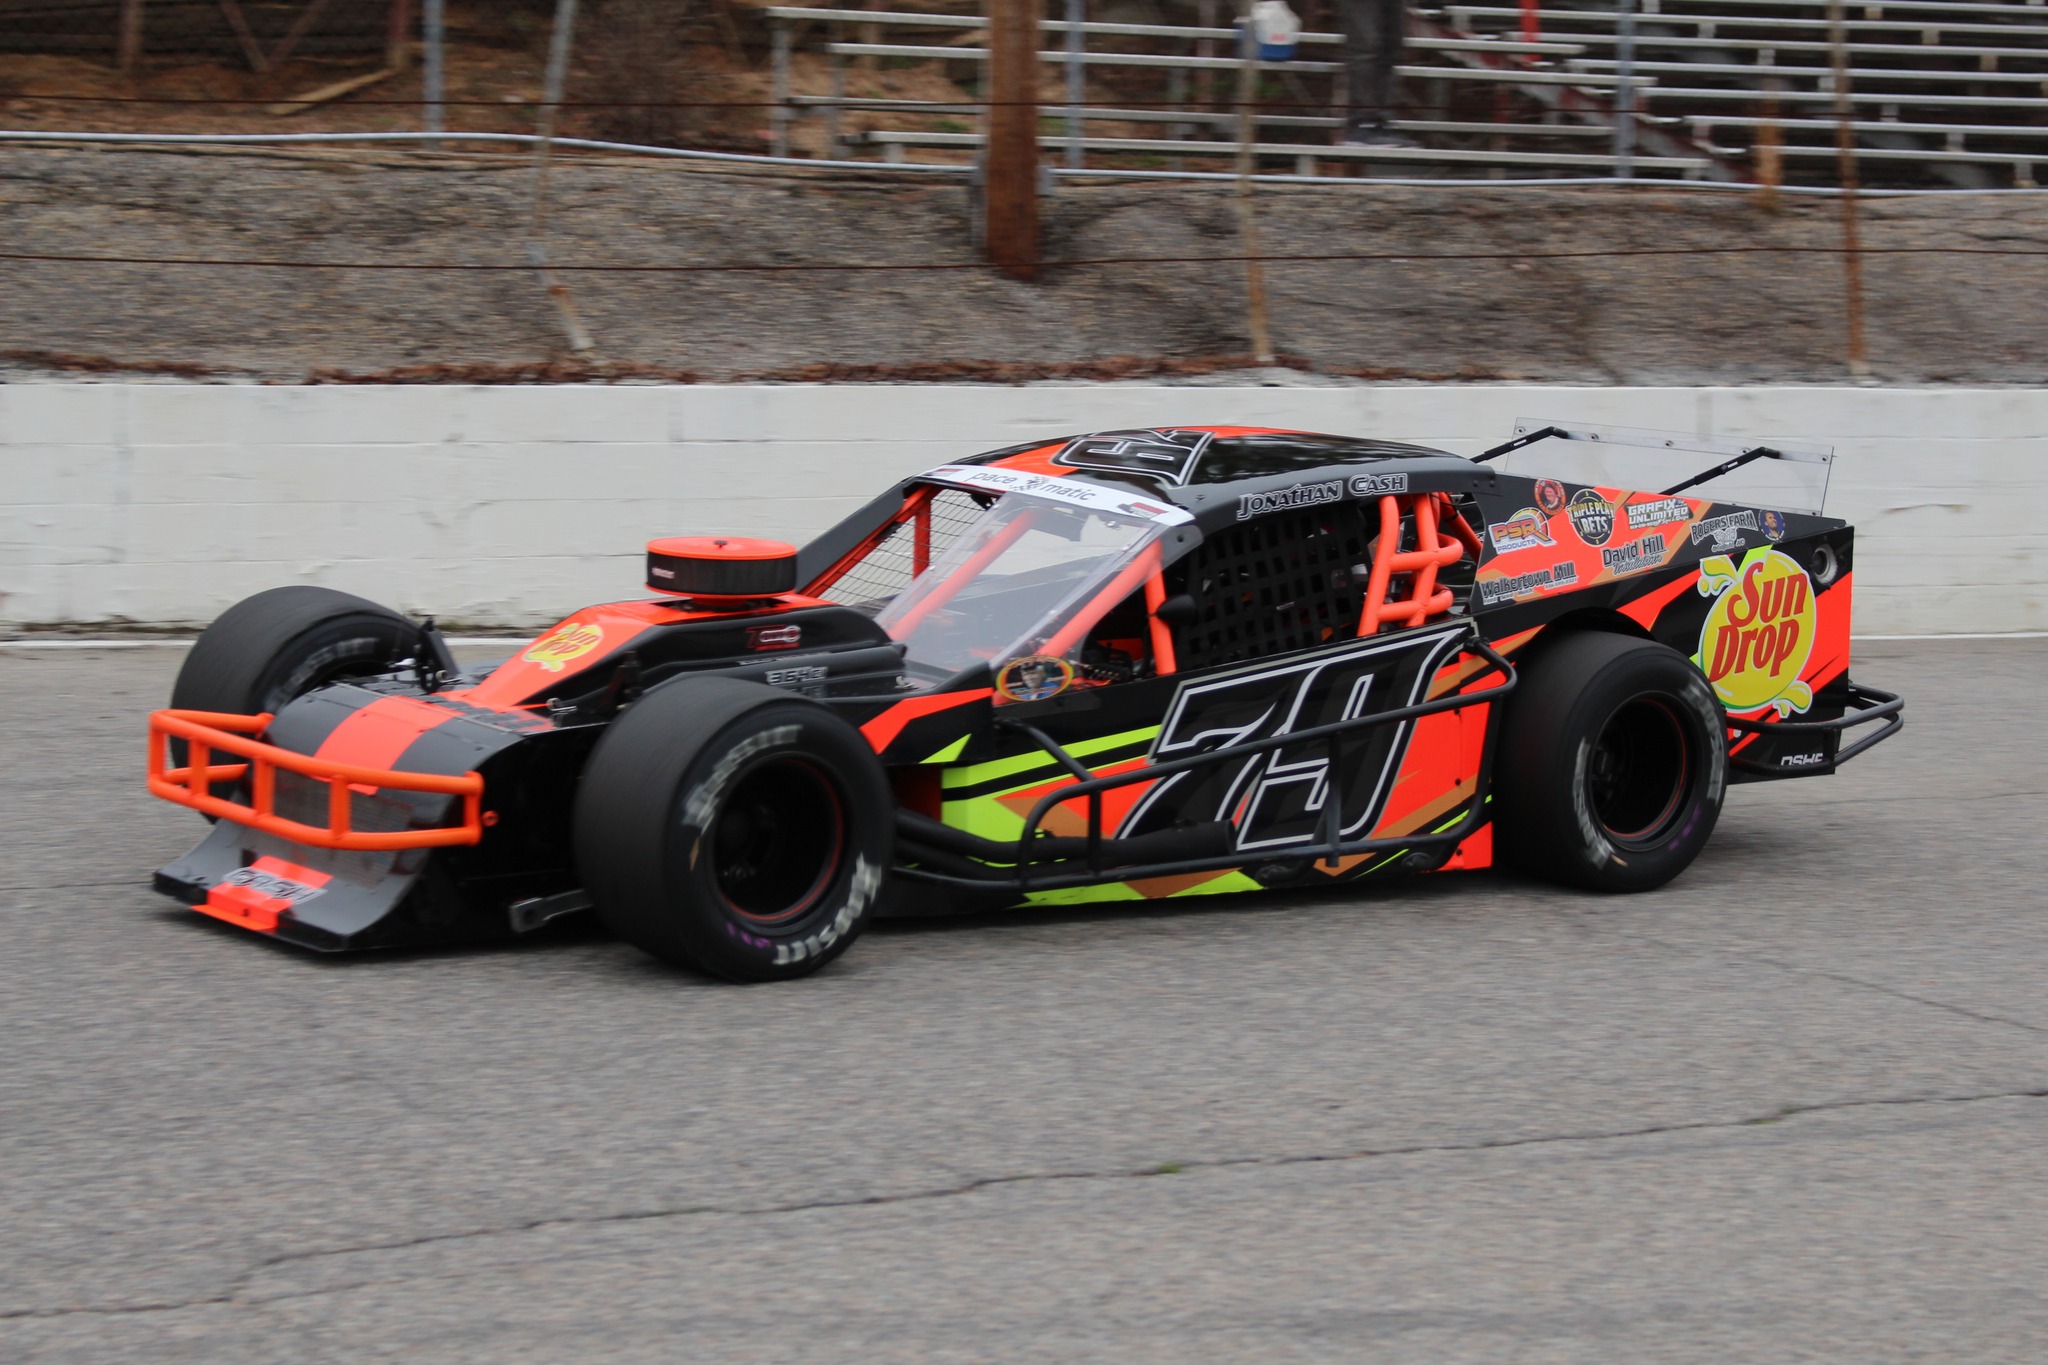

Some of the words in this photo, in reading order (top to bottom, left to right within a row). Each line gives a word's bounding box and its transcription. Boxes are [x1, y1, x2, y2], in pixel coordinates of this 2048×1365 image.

[965, 471, 1018, 485] pace
[1039, 482, 1097, 501] matic
[1237, 481, 1343, 521] JONATHAN
[1349, 473, 1408, 496] CASH
[1567, 502, 1593, 522] TRIPLE
[1593, 501, 1614, 519] PLAY
[1628, 498, 1676, 515] GRAFIX
[1629, 506, 1689, 525] UNLIMITED
[1491, 518, 1552, 543] PSR
[1580, 516, 1608, 534] BETS
[1690, 515, 1729, 544] ROGERS
[1728, 510, 1758, 531] FARM
[1497, 539, 1537, 552] PRODUCTS
[1602, 541, 1638, 567] David
[1641, 534, 1665, 555] Hill
[1480, 569, 1551, 599] Walkertown
[1553, 561, 1577, 581] Mill
[1727, 562, 1808, 627] Sun
[1709, 619, 1800, 683] Drop
